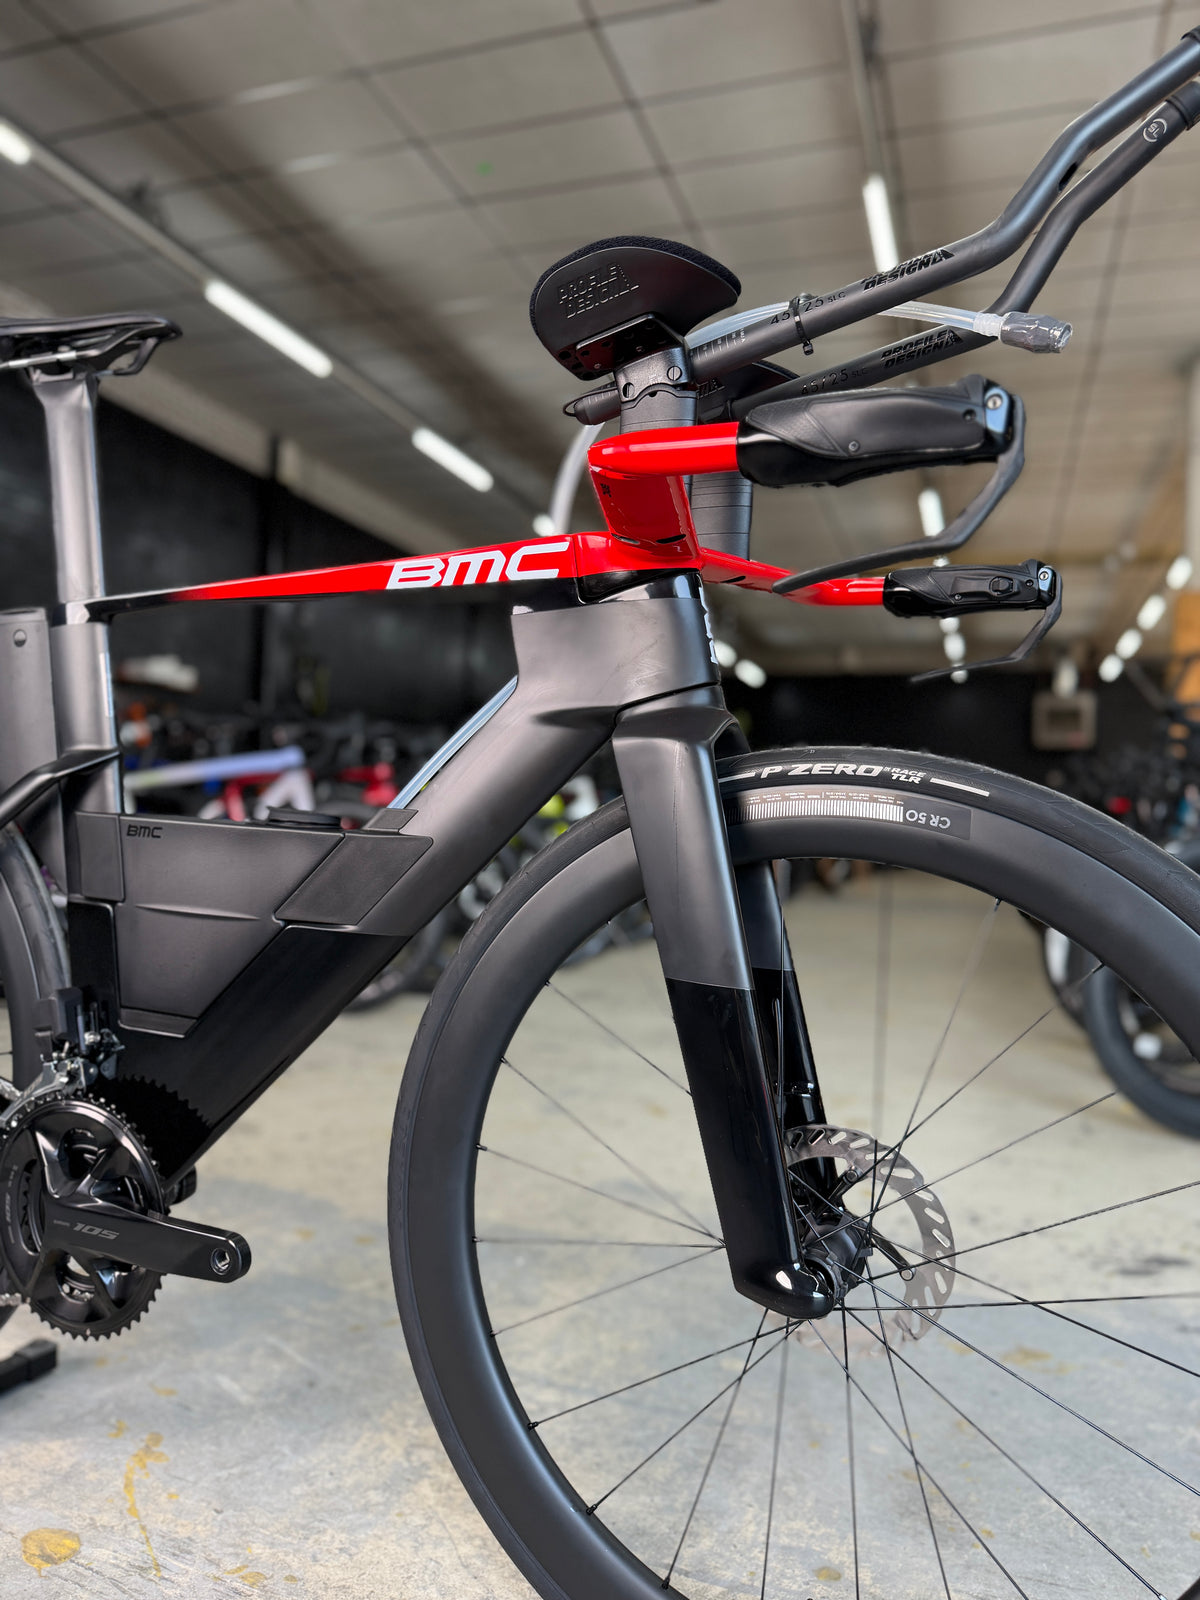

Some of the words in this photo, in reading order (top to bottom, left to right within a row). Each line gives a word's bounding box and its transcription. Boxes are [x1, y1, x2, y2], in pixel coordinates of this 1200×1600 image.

[881, 329, 949, 359] PROFILE
[386, 542, 570, 590] BMC
[760, 765, 783, 779] P
[787, 763, 884, 777] ZERO
[890, 767, 927, 778] RACE
[891, 774, 922, 784] TLR
[905, 809, 926, 825] 50
[929, 813, 951, 829] CR
[126, 824, 163, 839] BMC
[73, 1222, 120, 1241] 105
